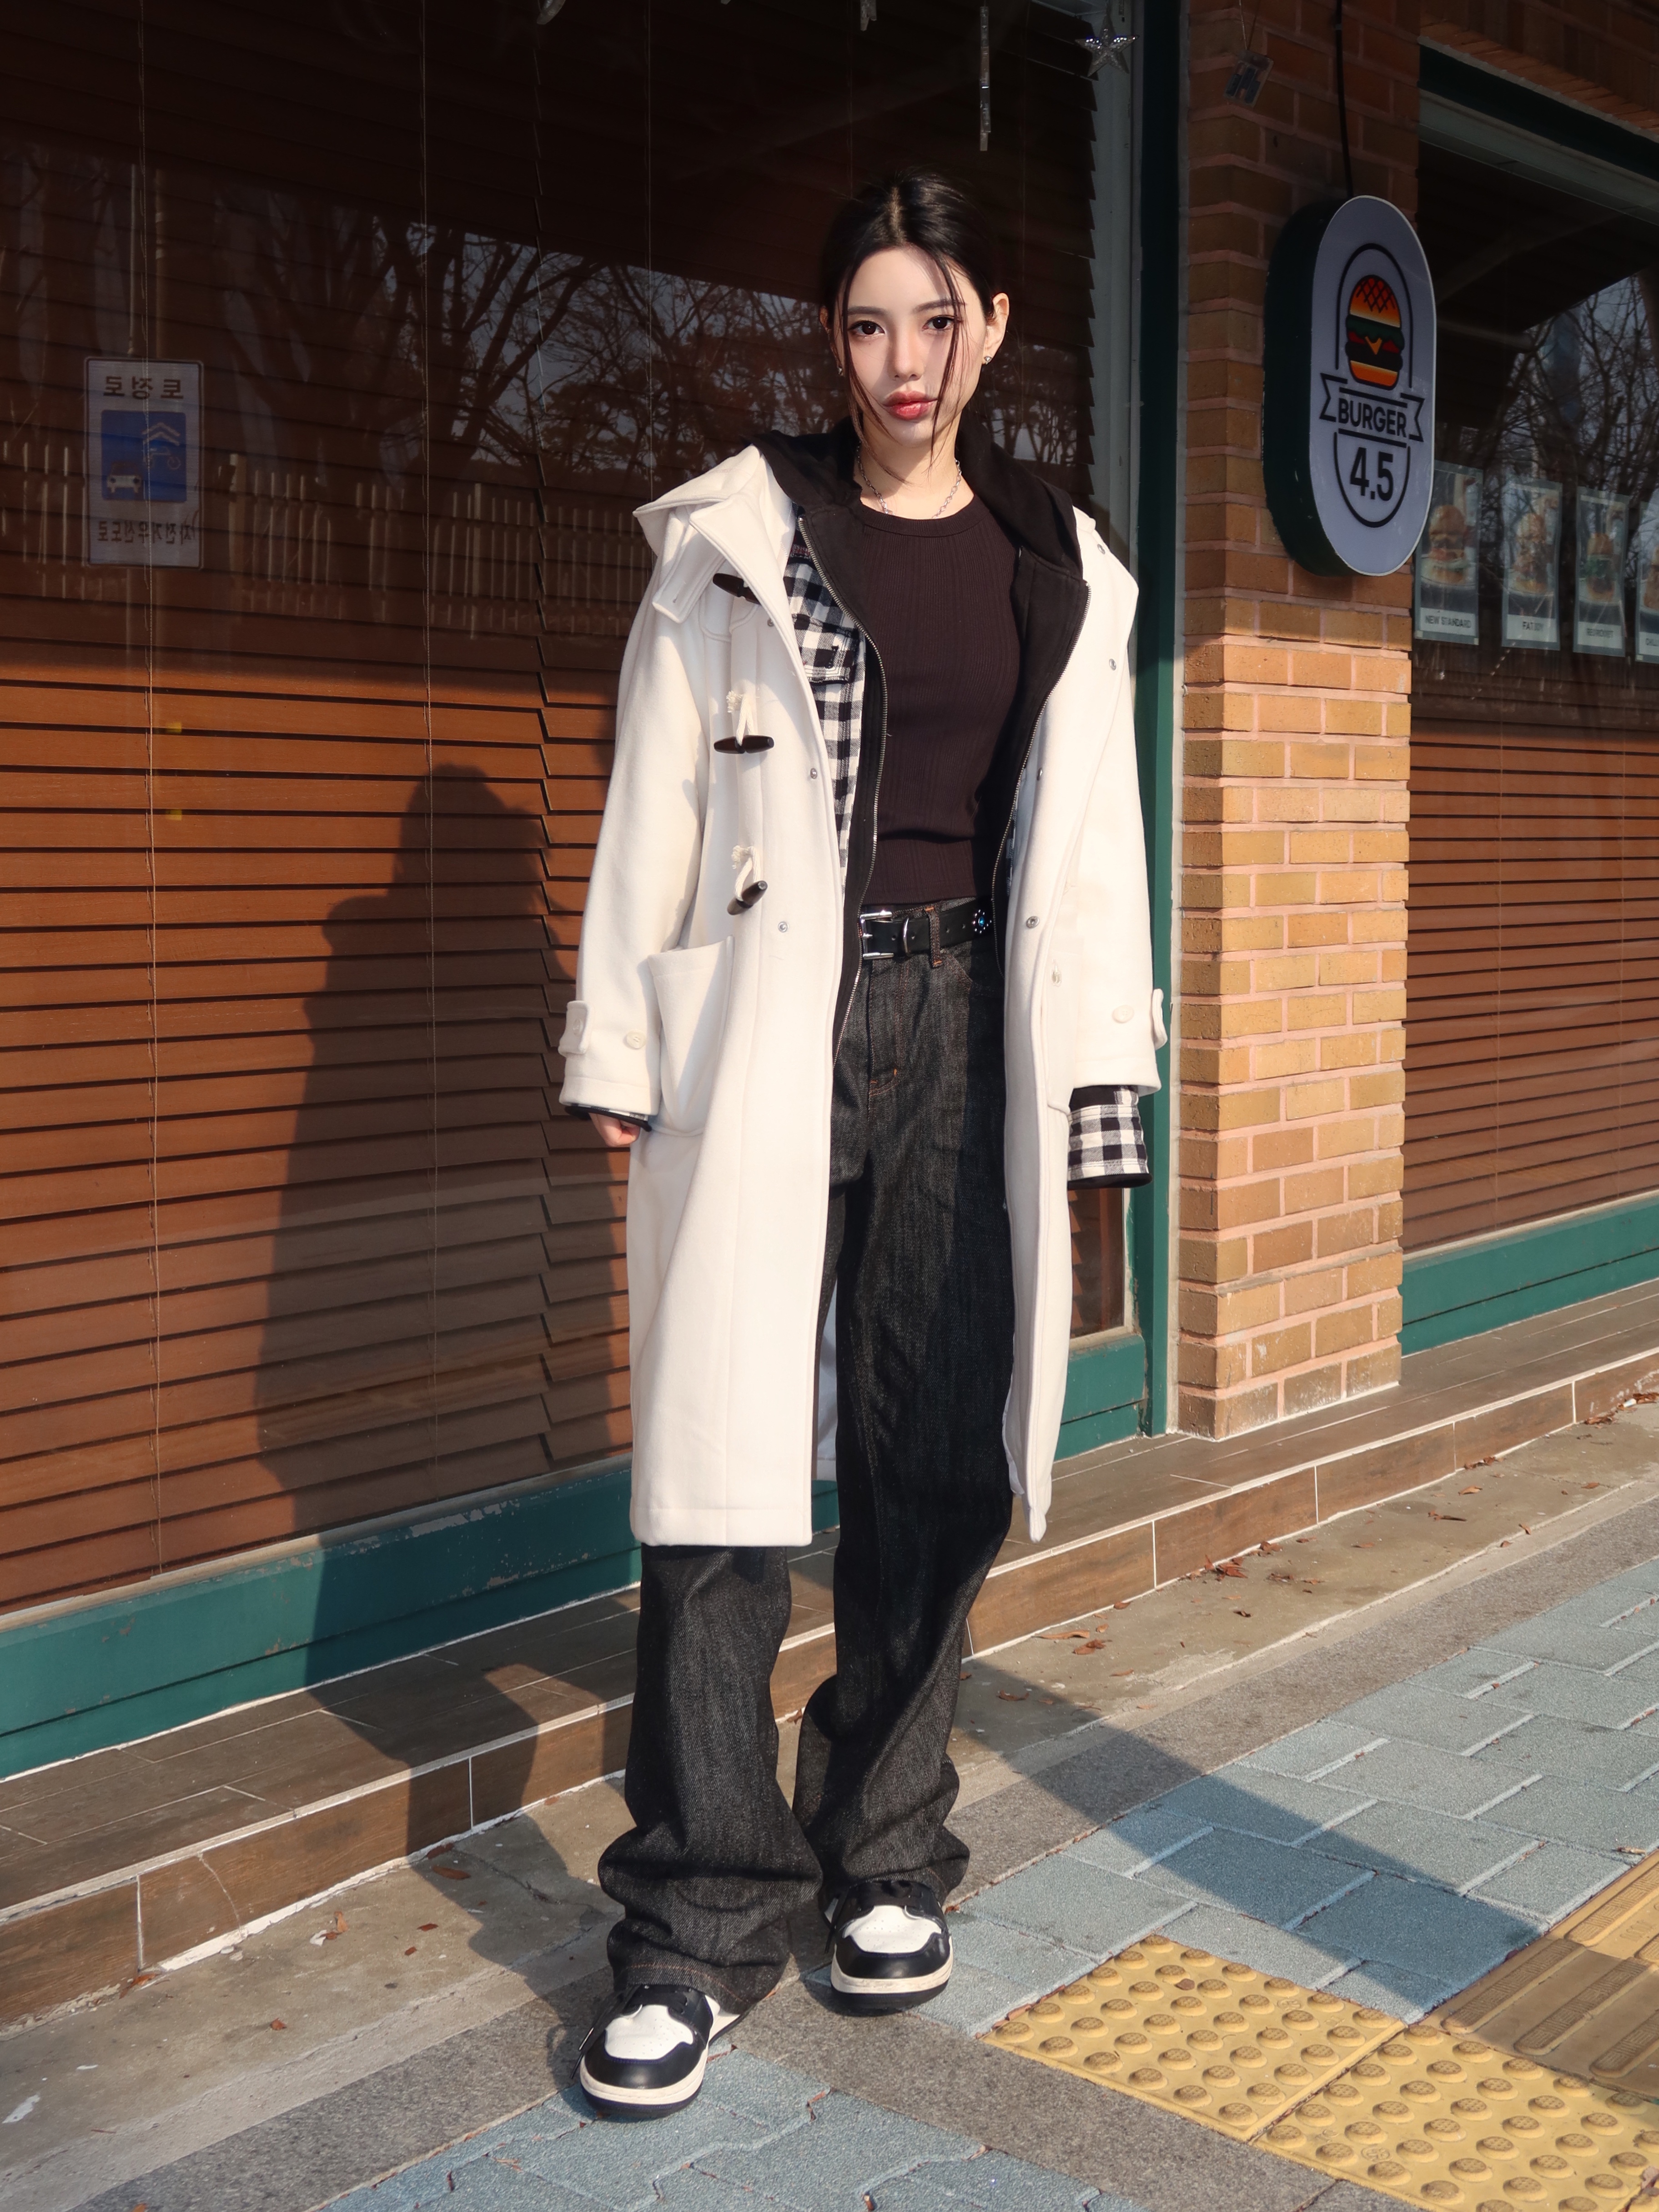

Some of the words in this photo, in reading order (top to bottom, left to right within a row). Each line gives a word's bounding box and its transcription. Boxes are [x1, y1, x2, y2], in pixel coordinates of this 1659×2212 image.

[1338, 397, 1407, 438] BURGER
[1350, 446, 1394, 502] 4.5
[1425, 615, 1440, 624] NEW
[1441, 616, 1472, 628] STANDARD
